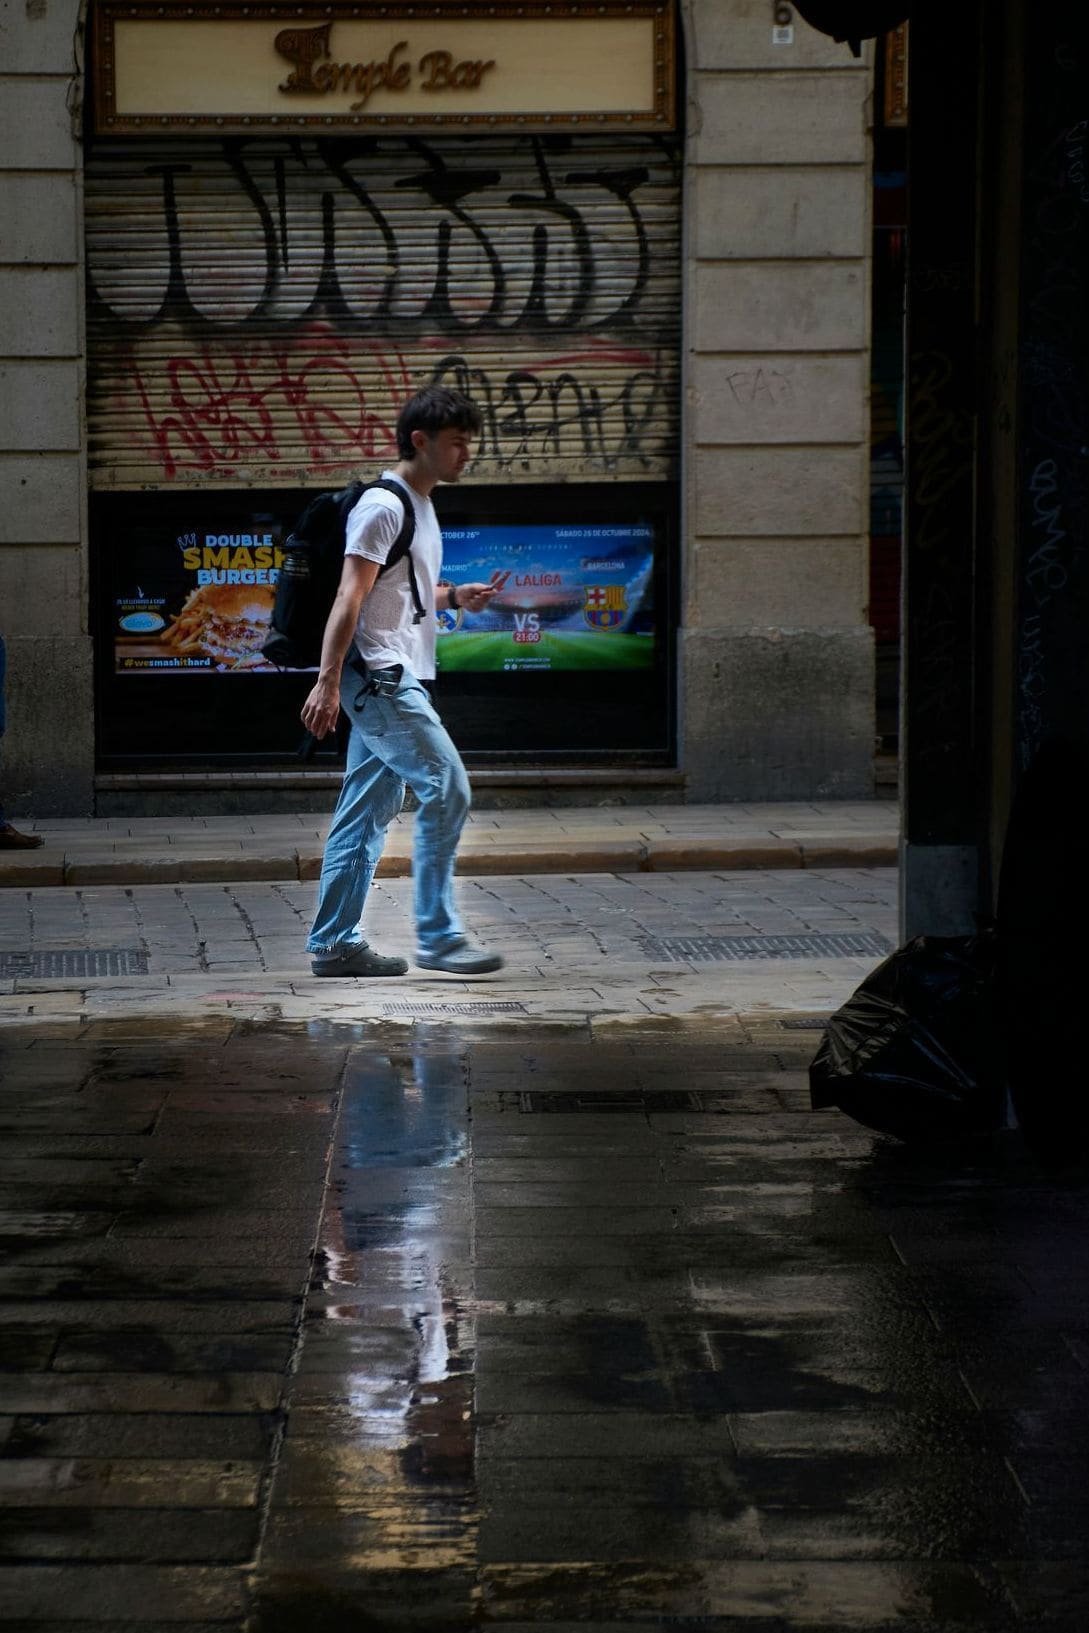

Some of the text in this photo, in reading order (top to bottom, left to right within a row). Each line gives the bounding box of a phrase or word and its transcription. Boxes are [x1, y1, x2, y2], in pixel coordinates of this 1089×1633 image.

[273, 22, 495, 113] Temple Bar
[205, 534, 273, 547] DOUBLE
[441, 564, 467, 572] MADRID
[587, 561, 625, 570] BARCELONA
[514, 573, 562, 587] LALIGA
[513, 613, 541, 632] VS
[515, 632, 540, 642] 21:00
[124, 657, 211, 667] #wesmashithard
